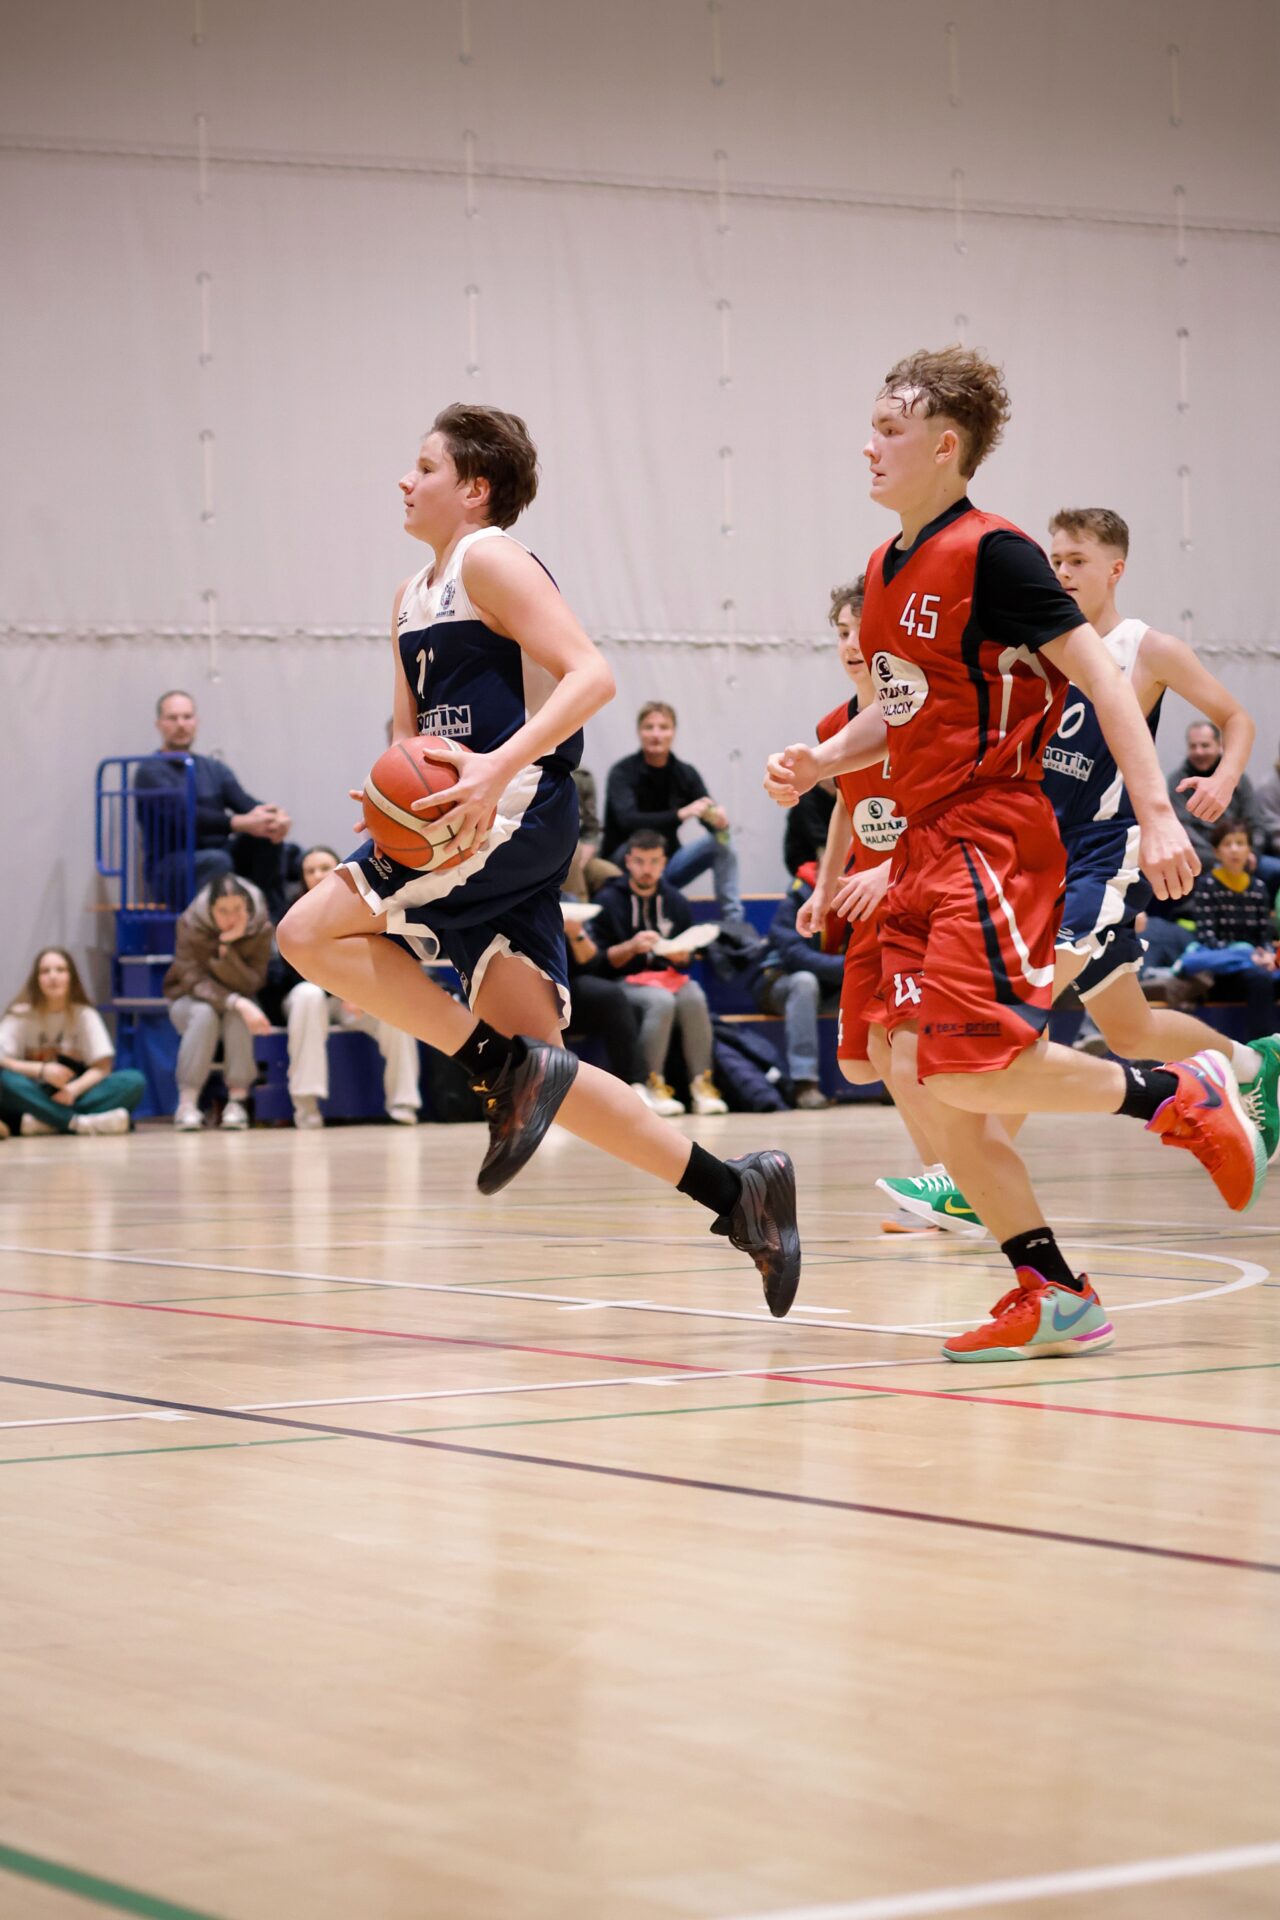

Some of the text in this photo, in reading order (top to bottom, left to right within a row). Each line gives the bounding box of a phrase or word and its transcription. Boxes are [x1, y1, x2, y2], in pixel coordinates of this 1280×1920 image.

[900, 592, 941, 639] 45
[430, 726, 470, 737] KADEMIE
[893, 971, 923, 1007] 4
